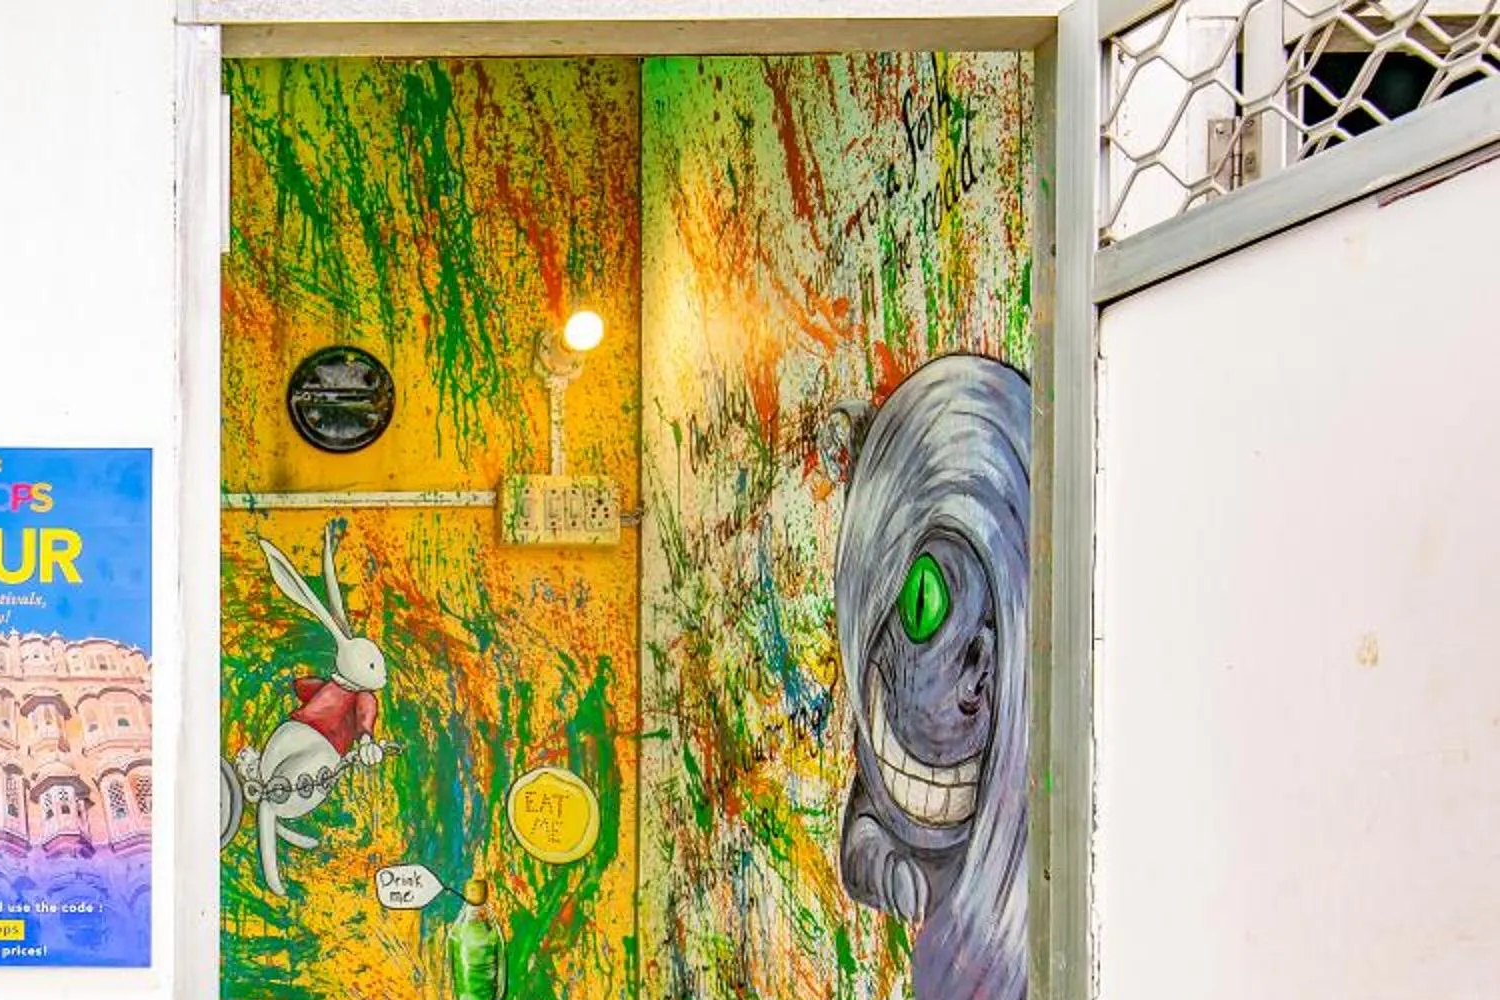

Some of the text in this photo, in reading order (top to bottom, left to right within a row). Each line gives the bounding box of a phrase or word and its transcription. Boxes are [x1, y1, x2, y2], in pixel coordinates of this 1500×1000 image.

[379, 870, 425, 888] Drink
[389, 890, 415, 905] me
[8, 904, 31, 913] use
[35, 901, 56, 913] the
[61, 902, 94, 913] code
[1, 945, 48, 958] prices!
